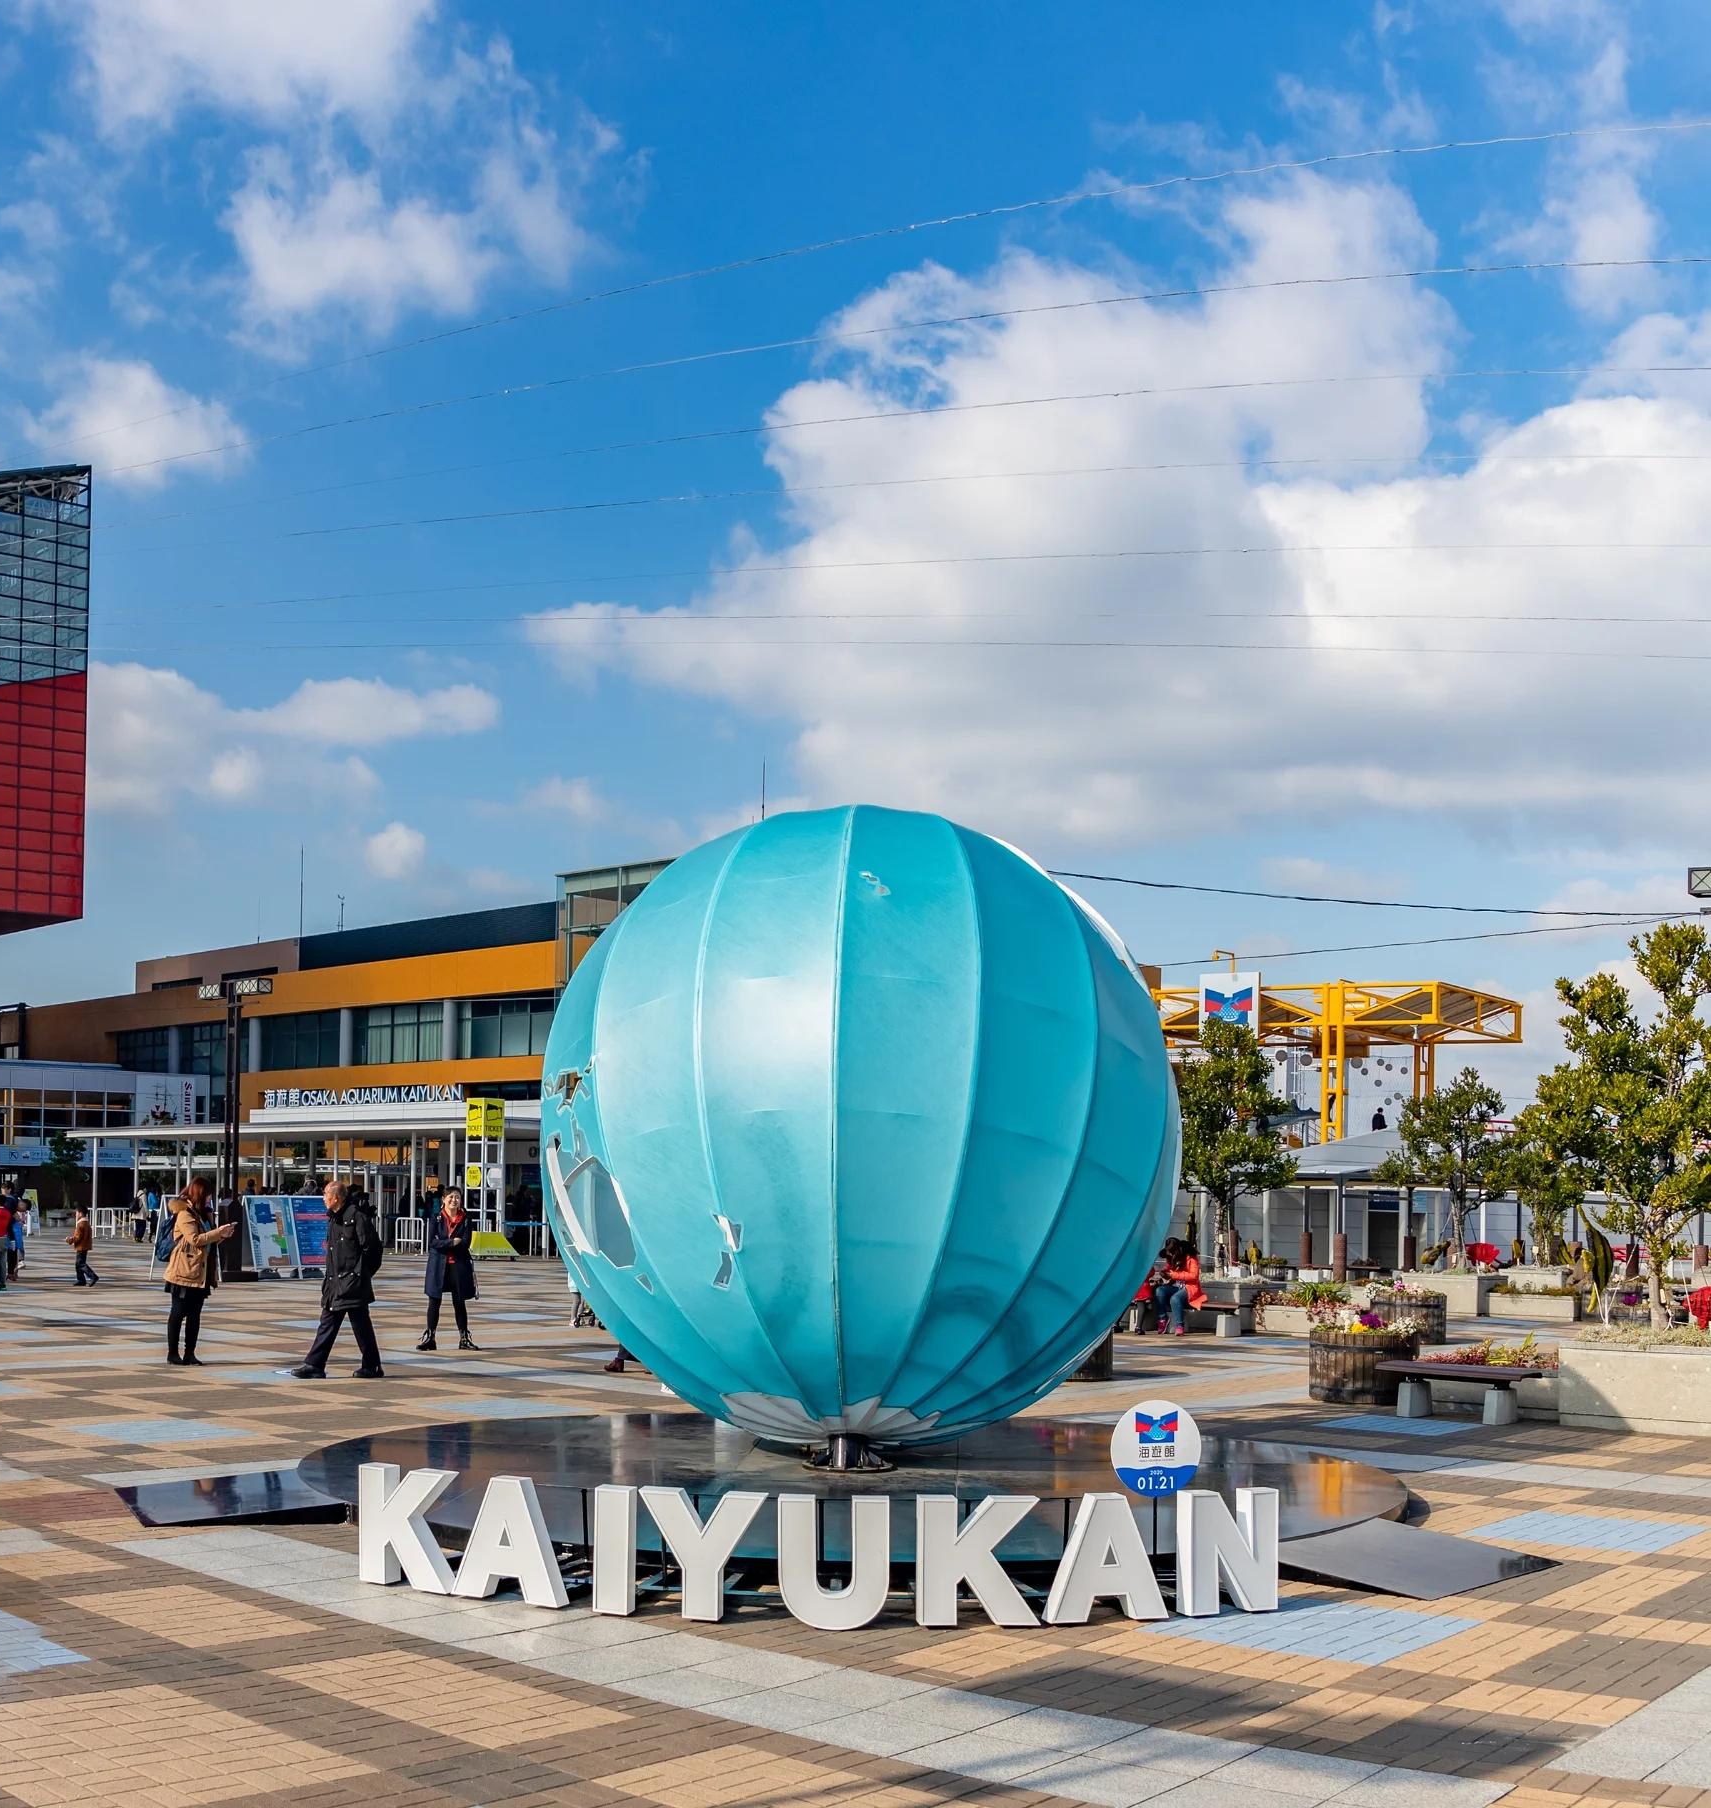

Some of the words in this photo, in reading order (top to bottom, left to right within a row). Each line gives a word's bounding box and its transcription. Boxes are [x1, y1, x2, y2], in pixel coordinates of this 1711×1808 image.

[264, 1088, 300, 1108] 海遊館
[301, 1089, 338, 1106] OSAKA
[340, 1086, 399, 1105] AQUARIUM
[400, 1083, 464, 1103] KAIYUKAN
[485, 1125, 503, 1133] TICKET
[1138, 1445, 1175, 1458] 海遊館
[1137, 1475, 1174, 1490] 01.21
[358, 1462, 1279, 1630] KAIYUKAN
